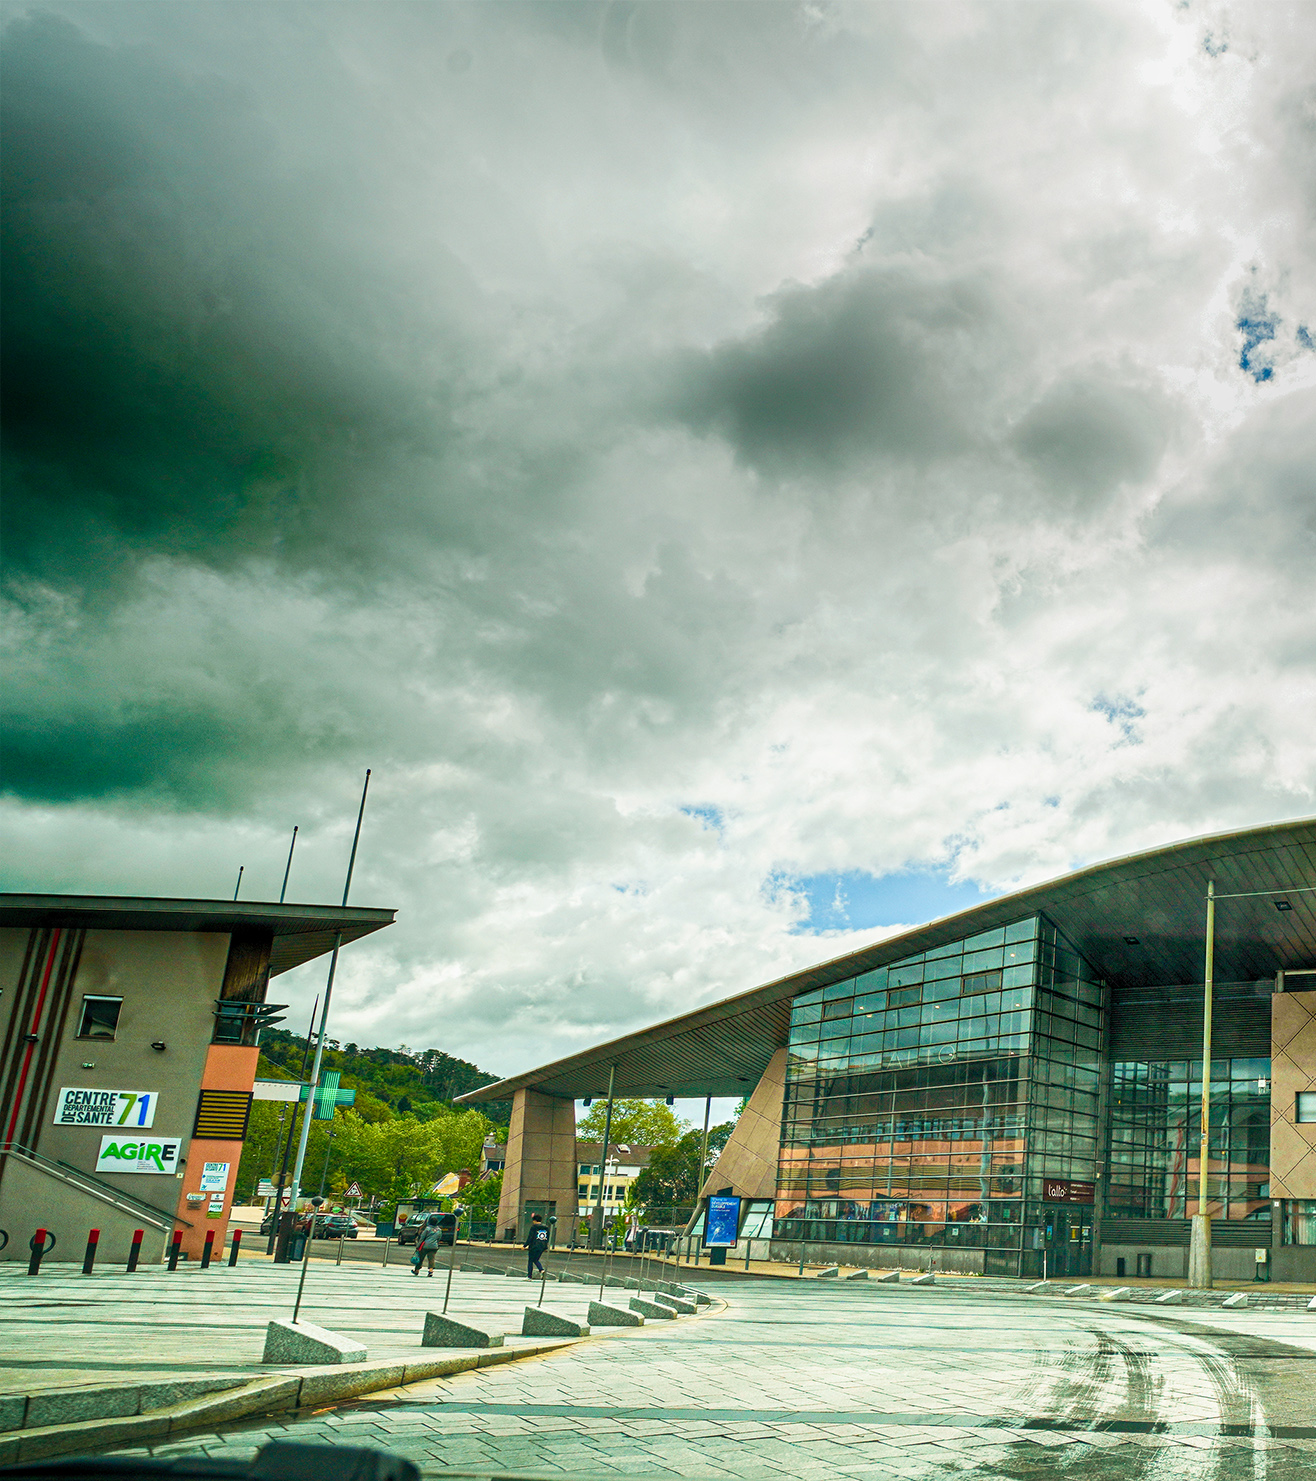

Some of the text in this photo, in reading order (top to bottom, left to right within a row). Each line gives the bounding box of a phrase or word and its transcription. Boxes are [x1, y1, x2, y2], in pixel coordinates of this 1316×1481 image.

[65, 1090, 118, 1106] CENTRE
[61, 1111, 76, 1122] DE
[117, 1093, 150, 1126] 71
